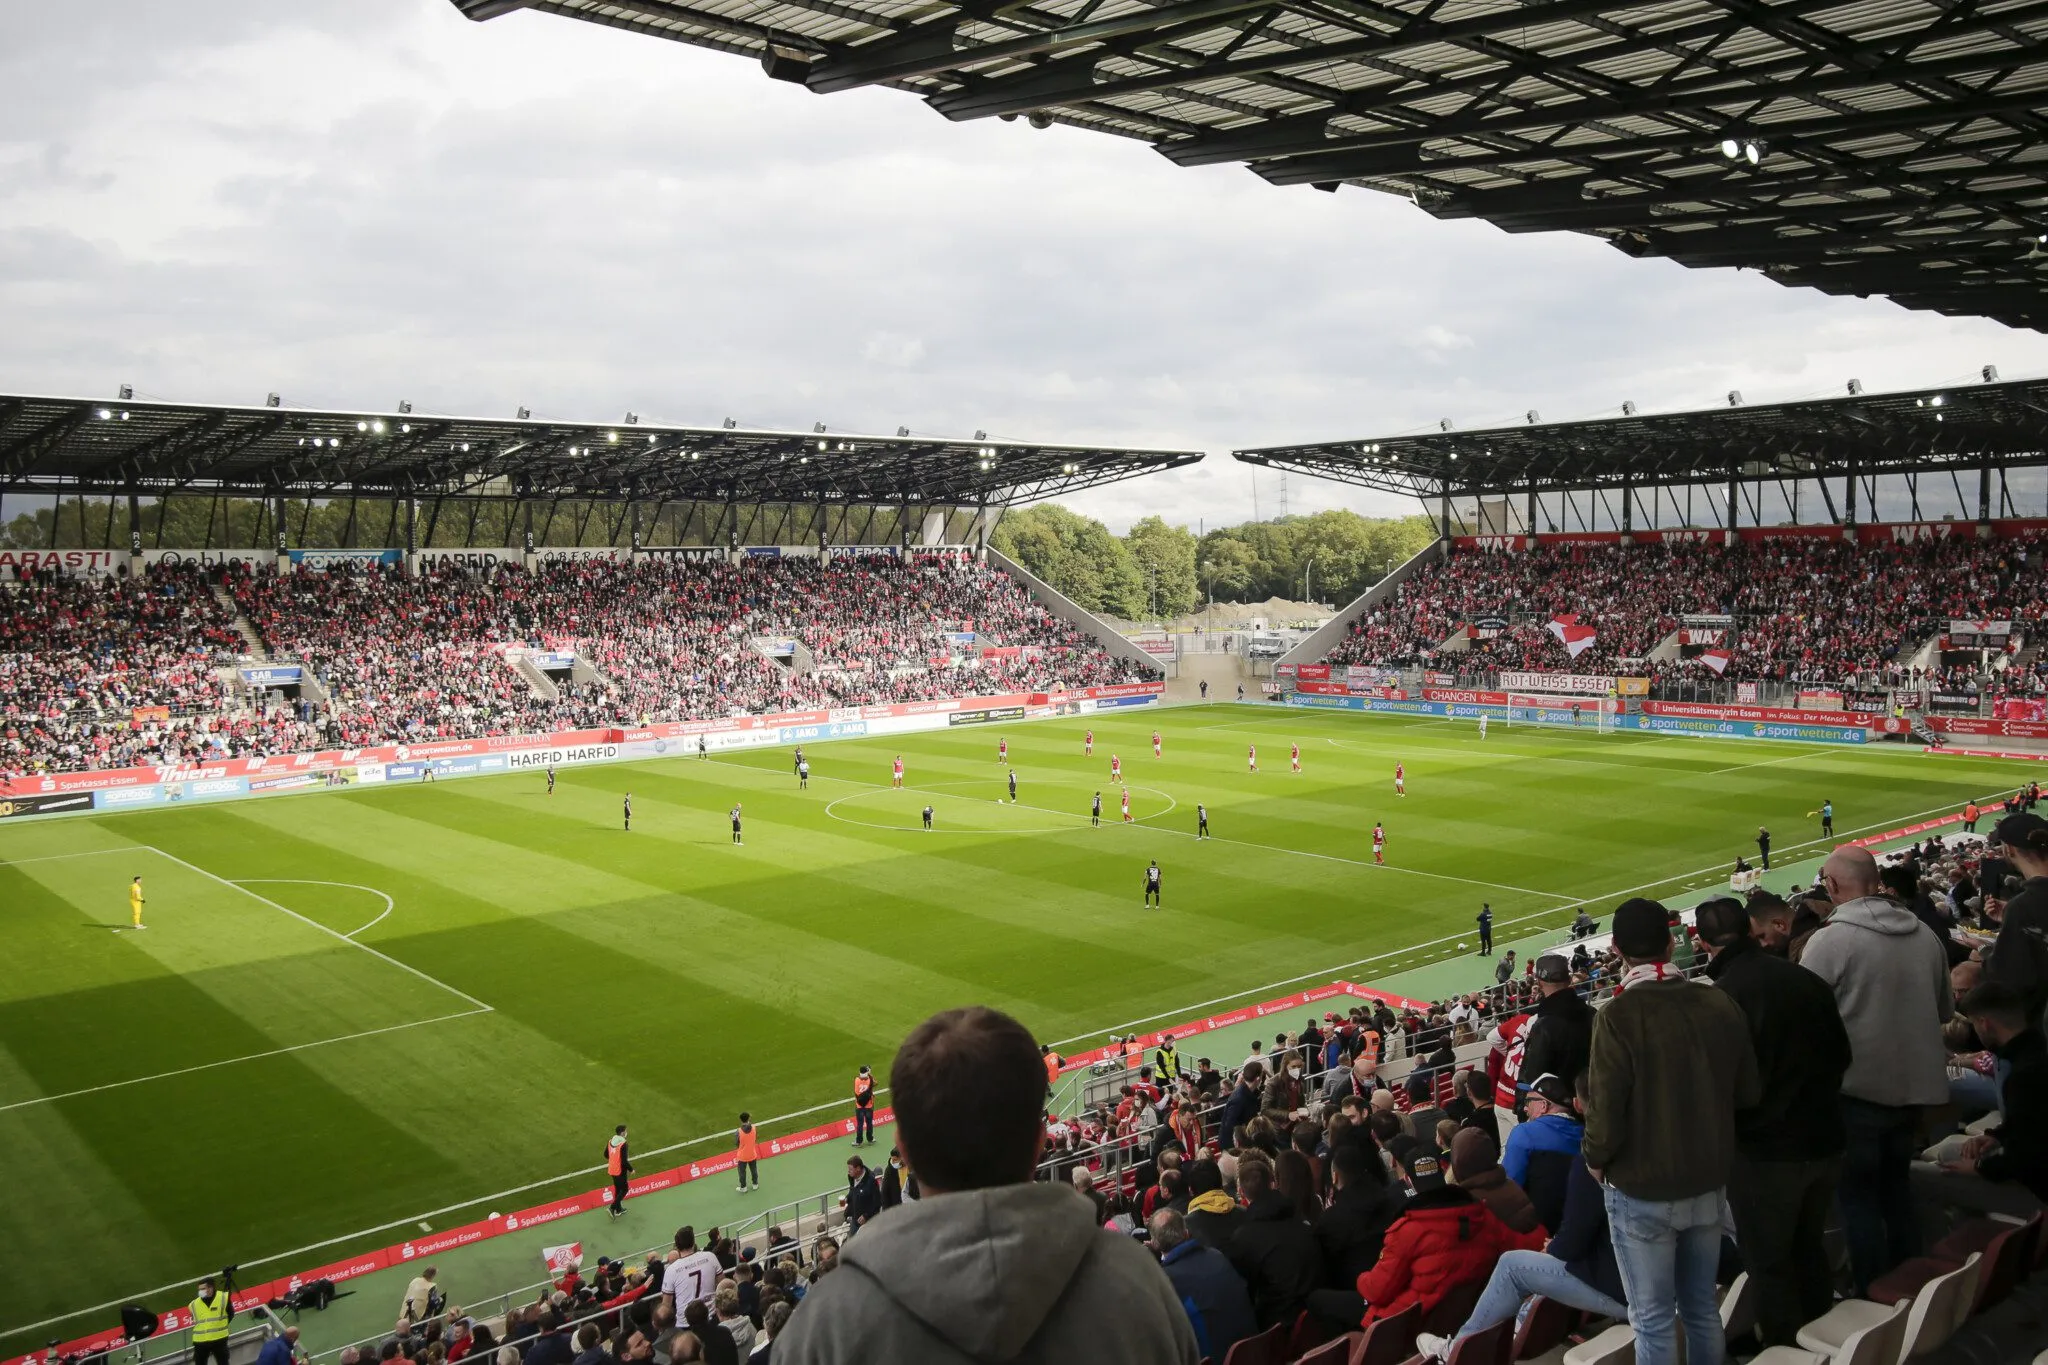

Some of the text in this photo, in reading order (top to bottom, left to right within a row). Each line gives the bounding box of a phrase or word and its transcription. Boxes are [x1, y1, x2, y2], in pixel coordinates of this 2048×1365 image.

[133, 531, 140, 540] R
[279, 532, 286, 540] R
[527, 532, 533, 540] R
[134, 540, 141, 549] 2
[279, 540, 286, 549] 2
[528, 539, 534, 547] 3
[1475, 537, 1515, 554] WAZ
[1261, 682, 1281, 694] WAZ
[1293, 695, 1349, 708] sportwetten.de
[1430, 691, 1477, 702] CHANCEN
[1372, 700, 1433, 713] sportwetten.de
[1740, 708, 1762, 718] Essen
[1820, 715, 1848, 723] Mensch
[843, 722, 865, 733] JAKO
[1651, 717, 1734, 734] sportwetten.de
[796, 728, 819, 738] JAKO
[1767, 725, 1860, 741] sportwetten.de
[412, 743, 473, 756] sportwetten.de
[448, 764, 477, 774] Essen!
[60, 776, 137, 790] Sparkasse Essen
[1215, 1016, 1235, 1028] Sparkasse
[782, 1132, 829, 1151] Sparkasse Essen
[702, 1160, 732, 1175] Sparkasse
[650, 1178, 670, 1190] Essen
[521, 1204, 580, 1227] Sparkasse Essen
[417, 1230, 482, 1255] Sparkasse Essen
[350, 1260, 376, 1276] Essen
[688, 1269, 702, 1299] 7
